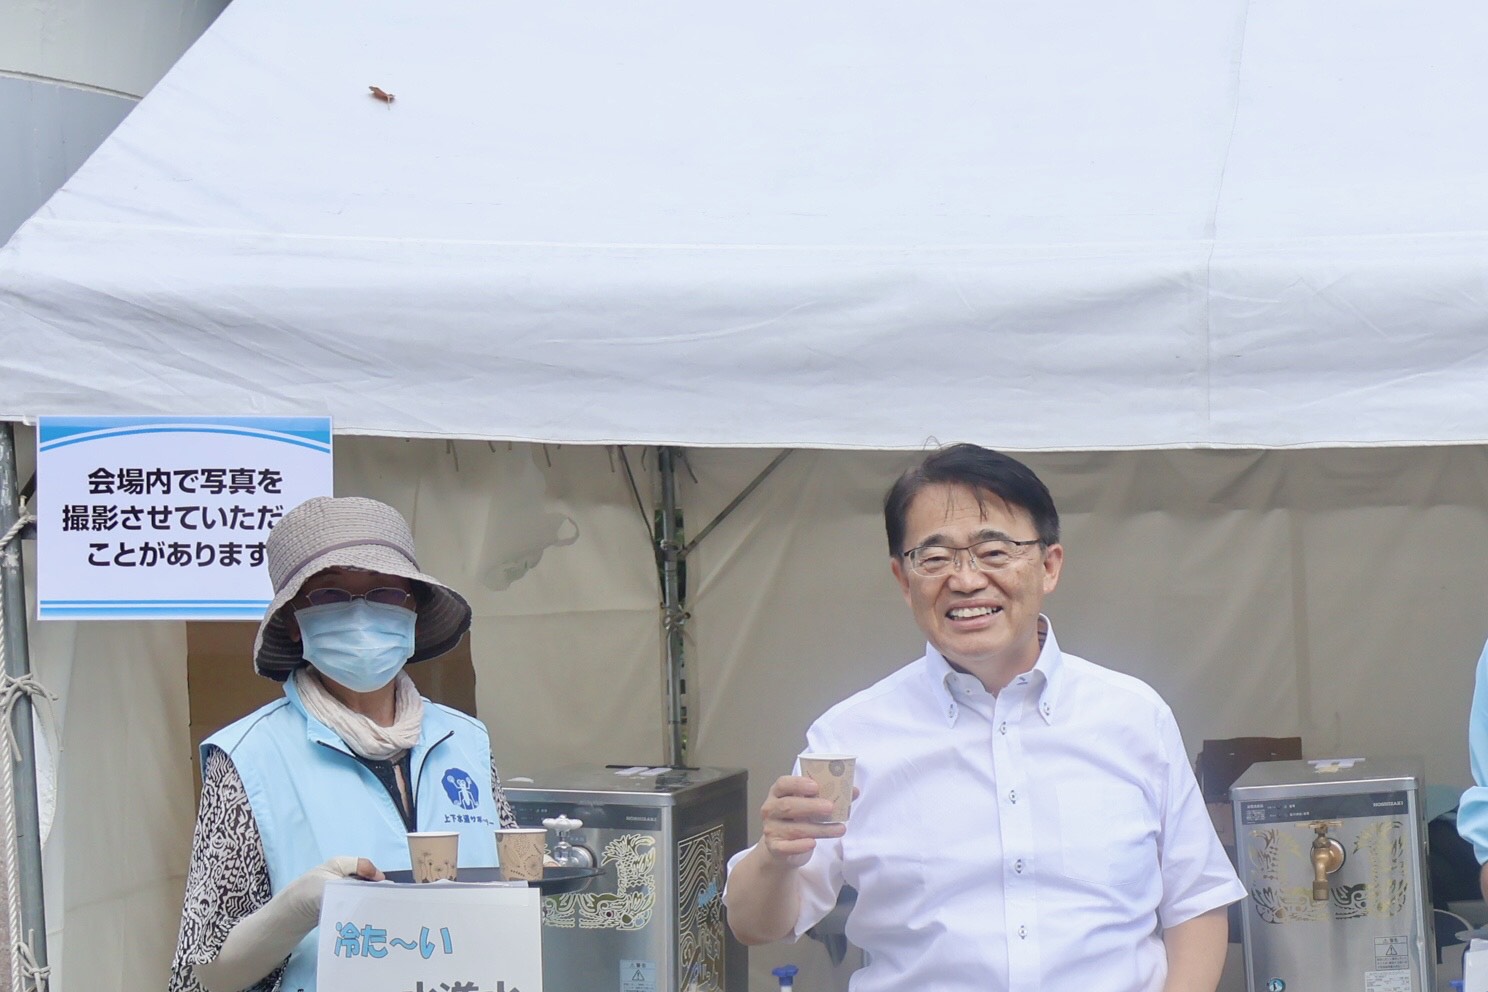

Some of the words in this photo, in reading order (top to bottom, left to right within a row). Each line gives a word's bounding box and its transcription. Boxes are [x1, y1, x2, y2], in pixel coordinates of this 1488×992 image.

[88, 468, 283, 495] 会場内で写真を
